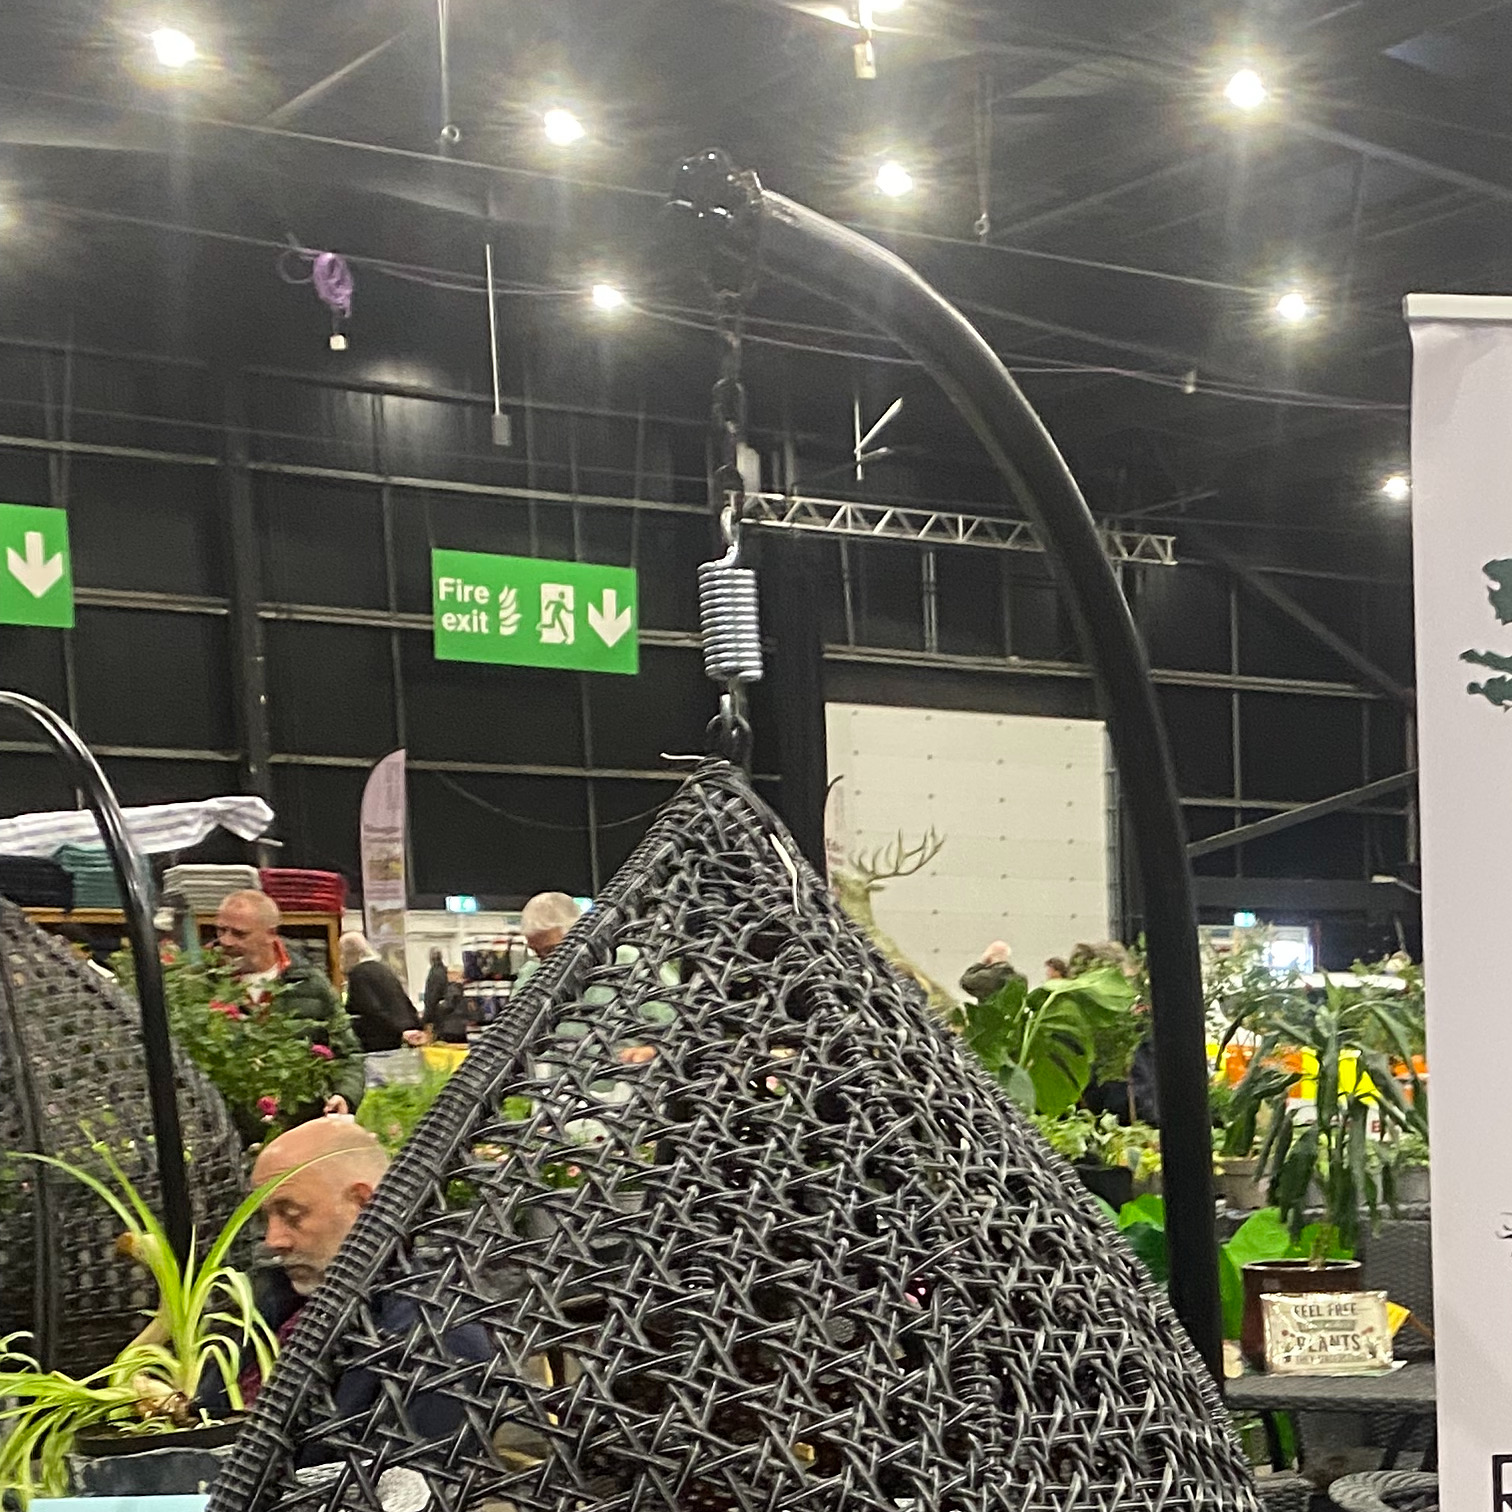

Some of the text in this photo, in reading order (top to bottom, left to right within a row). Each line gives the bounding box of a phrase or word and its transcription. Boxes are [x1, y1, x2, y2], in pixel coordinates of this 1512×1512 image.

[438, 577, 490, 604] Fire
[441, 609, 489, 634] exit
[1294, 1302, 1360, 1317] FEEL FREE
